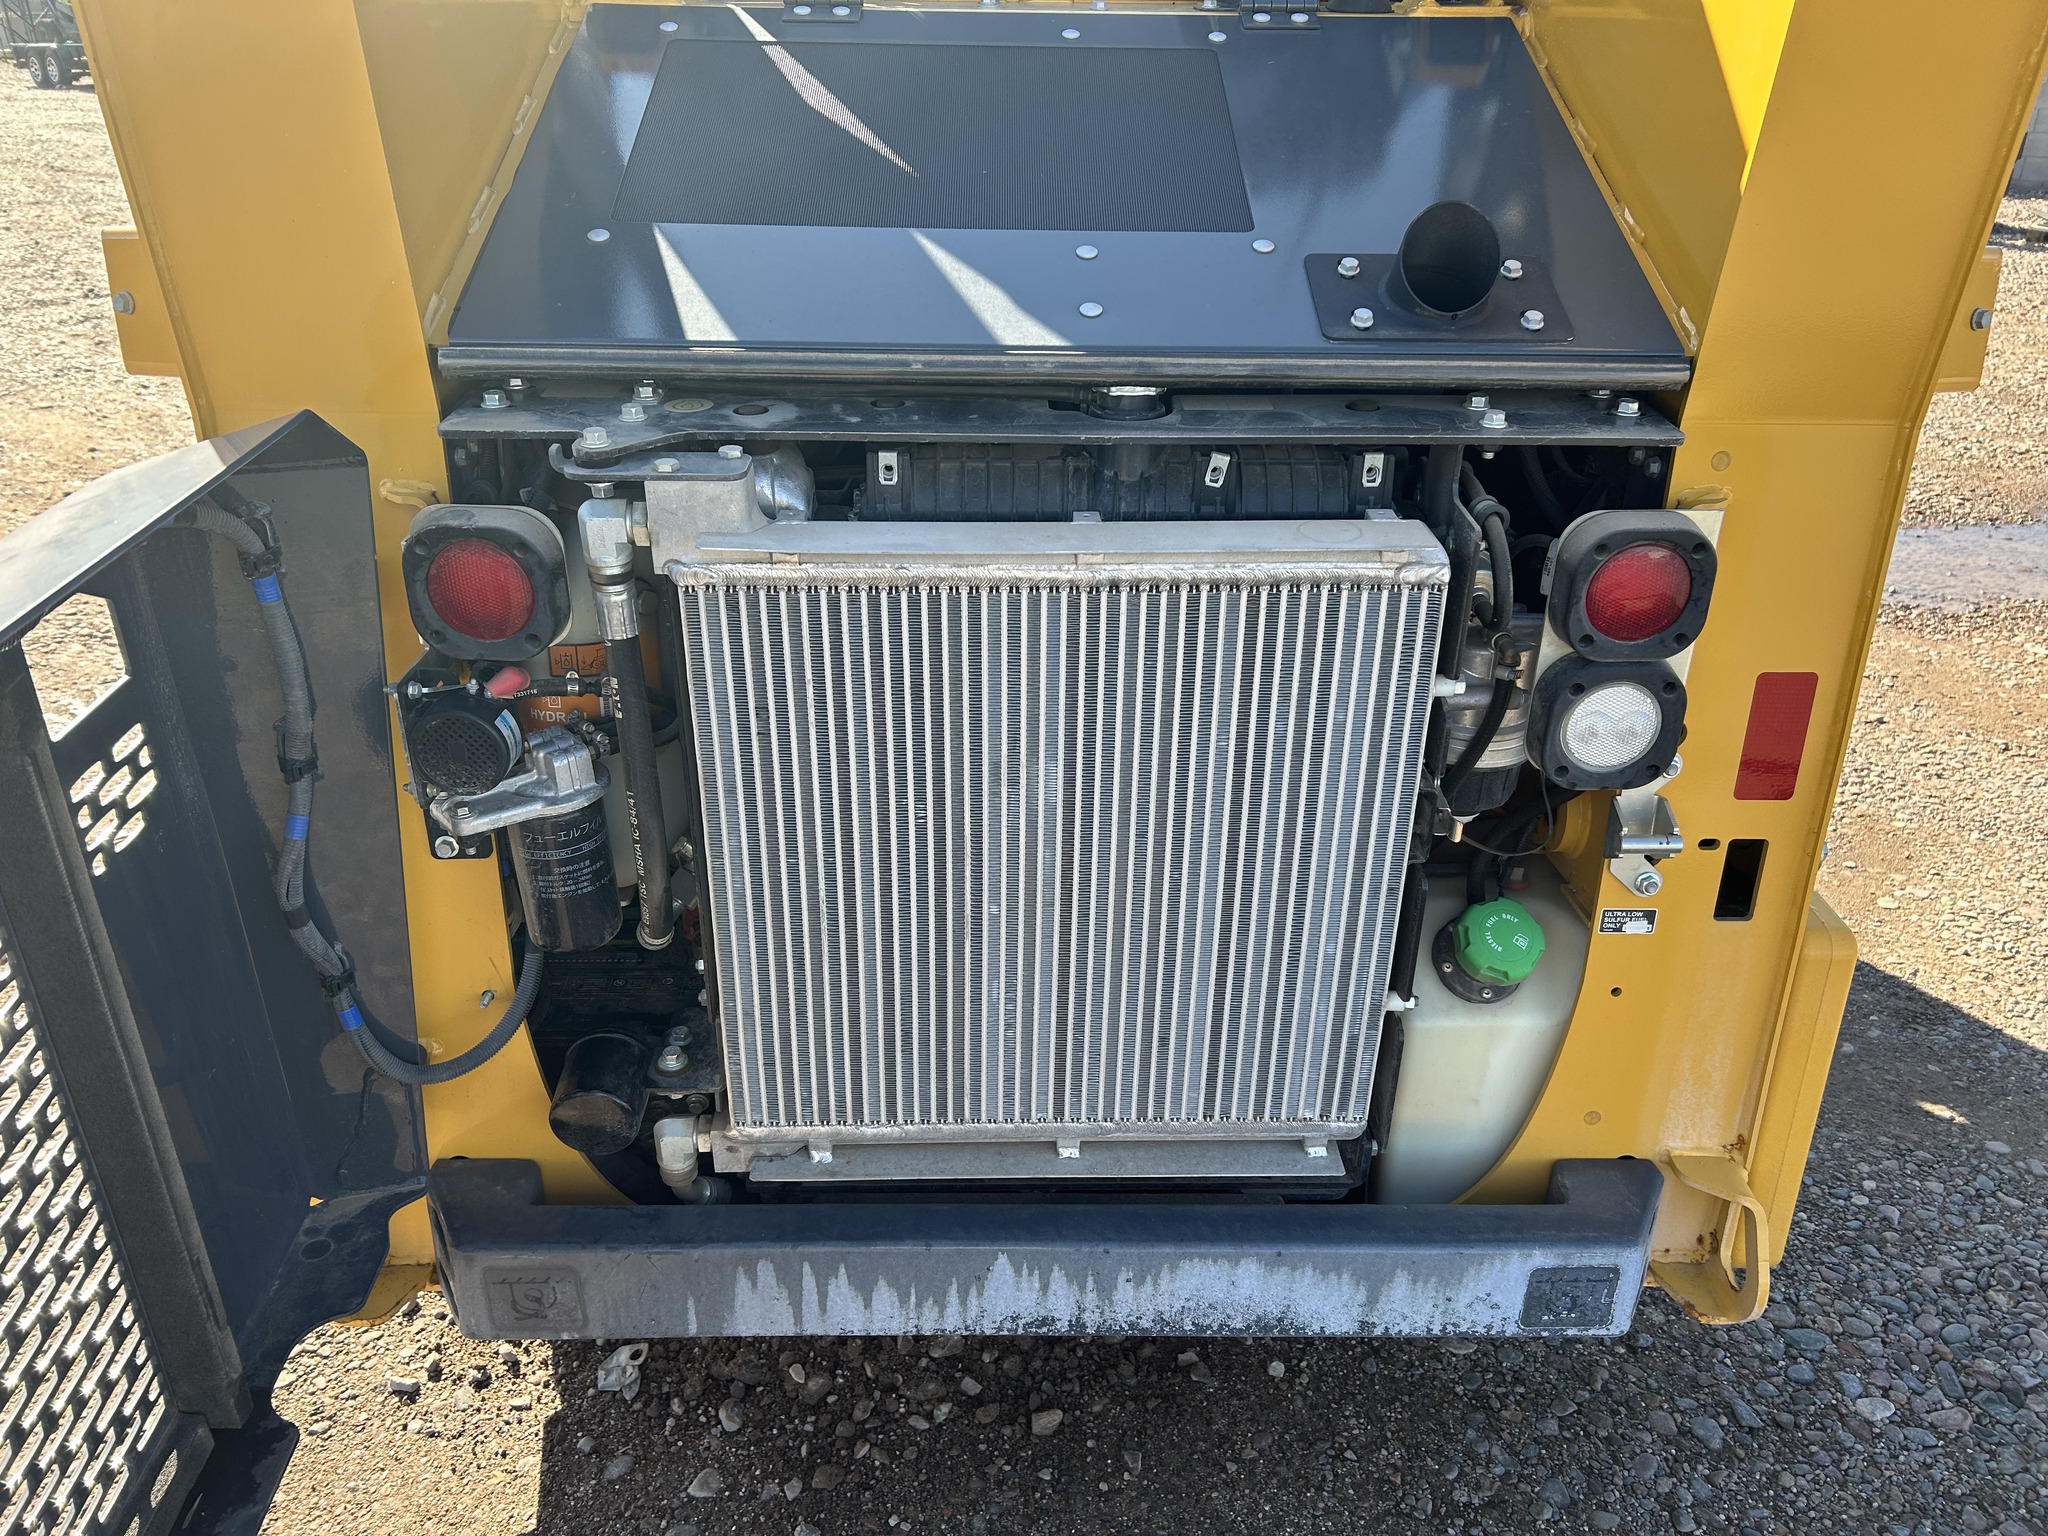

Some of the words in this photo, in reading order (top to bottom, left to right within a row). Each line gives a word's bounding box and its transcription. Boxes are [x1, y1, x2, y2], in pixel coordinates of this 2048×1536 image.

[634, 844, 645, 876] MSHA
[1486, 915, 1499, 927] FUEL
[1501, 913, 1519, 923] ONLY
[1485, 932, 1502, 952] DIESEL
